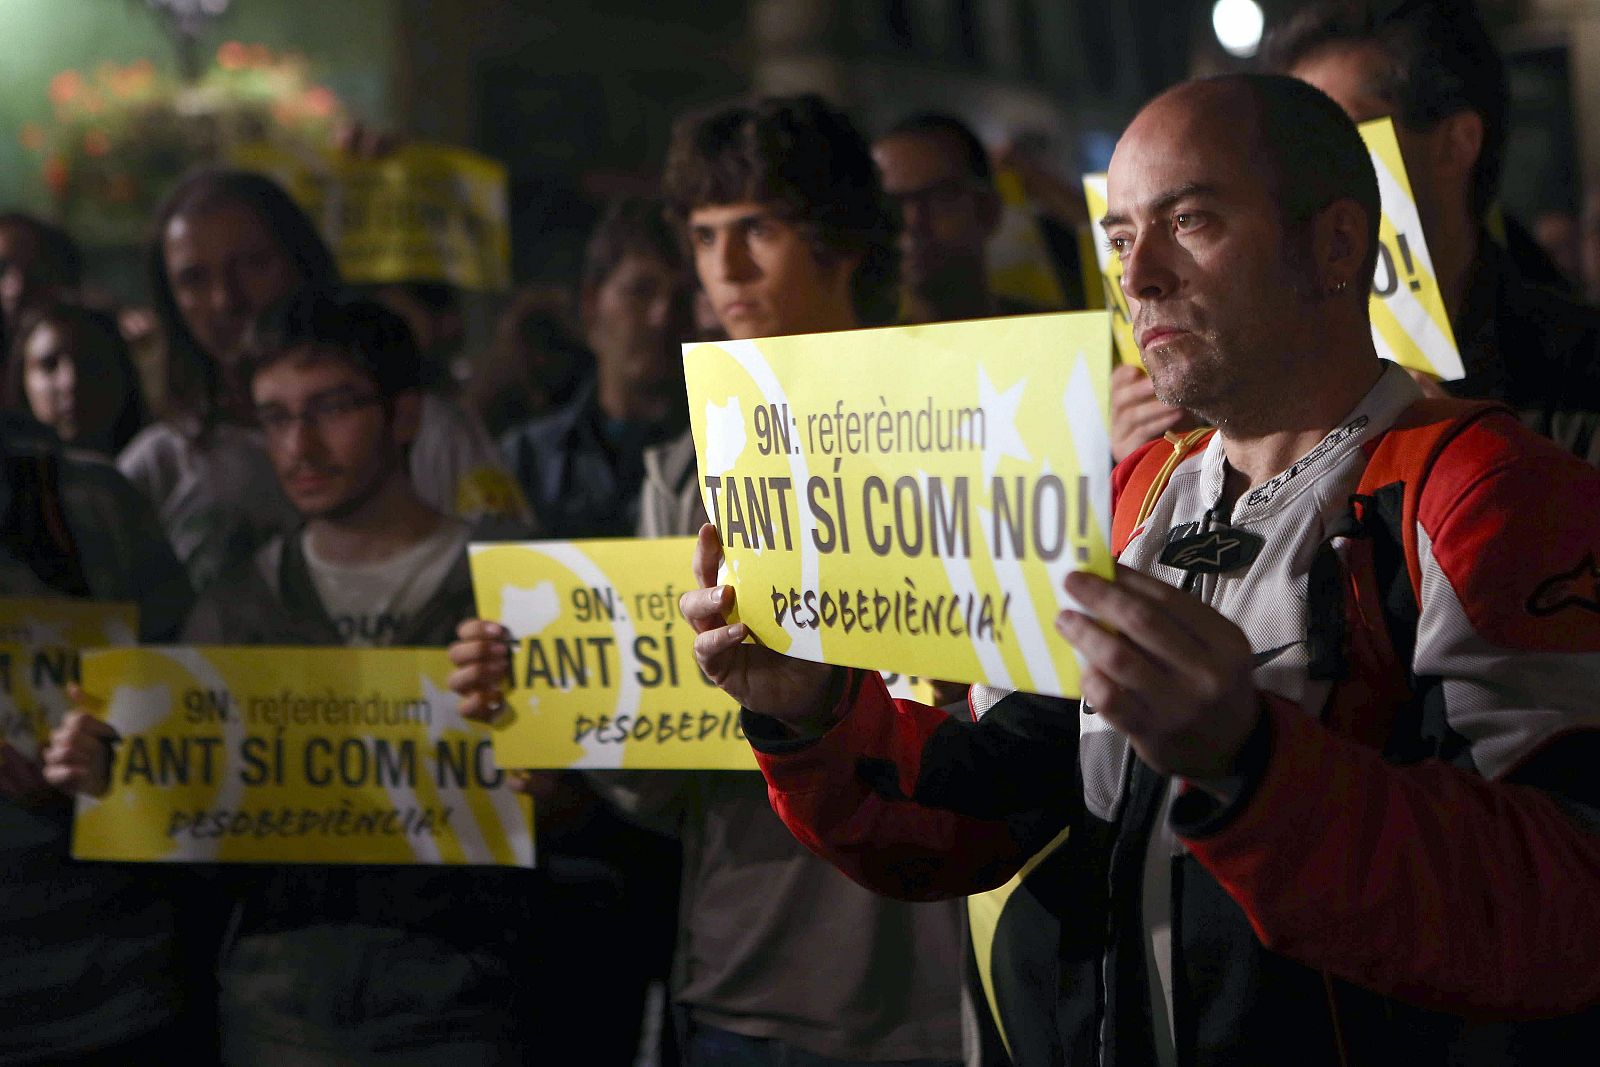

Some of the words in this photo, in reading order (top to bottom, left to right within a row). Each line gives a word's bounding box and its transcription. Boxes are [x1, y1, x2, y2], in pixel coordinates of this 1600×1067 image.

[754, 403, 799, 455] 9N:
[808, 396, 986, 454] referèndum
[705, 475, 793, 551] TANT
[806, 457, 850, 554] SÍ
[862, 475, 971, 558] COM
[992, 474, 1090, 562] NO!
[572, 586, 625, 623] 9N:
[770, 576, 1011, 642] DESOBEDIÈNCIA!
[503, 637, 613, 689] TANT
[632, 622, 679, 688] SÍ
[249, 686, 433, 726] referèndum
[239, 726, 285, 787] SÍ
[304, 737, 416, 788] COM
